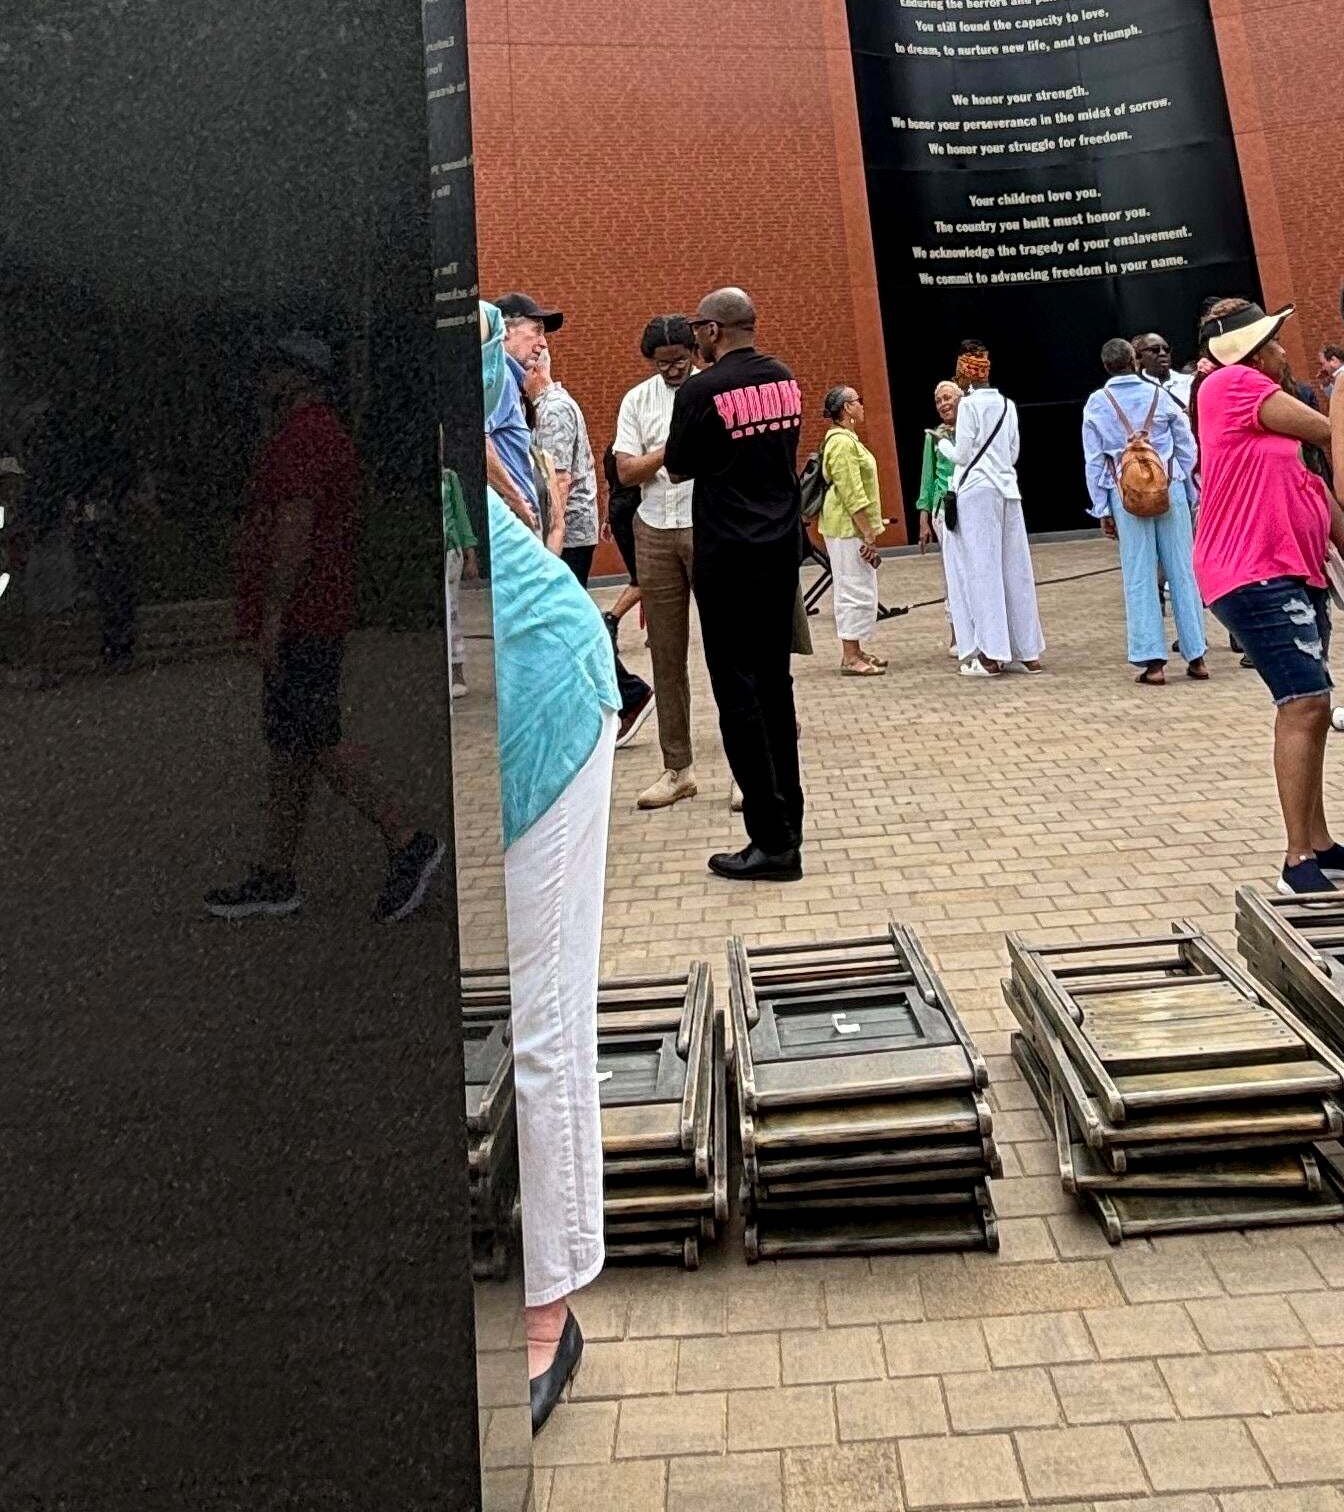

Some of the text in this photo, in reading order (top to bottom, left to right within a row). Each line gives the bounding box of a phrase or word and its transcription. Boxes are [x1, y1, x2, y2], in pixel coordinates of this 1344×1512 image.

[915, 9, 1109, 32] You still found the capacity to love,
[895, 24, 1142, 57] to dream, to nurture new life, and to triumph.
[952, 85, 1089, 106] We honor your strength.
[891, 97, 1171, 132] We honor your perseverance in the midst of sorrow.
[928, 130, 1132, 156] We honor your struggle for freedom.
[969, 188, 1102, 207] Your children love you.
[934, 208, 1151, 234] The country you built must honor you.
[912, 225, 1192, 259] We acknowledge the tragedy of your enslavement.
[918, 255, 1188, 285] We commit to advancing freedom in your name.
